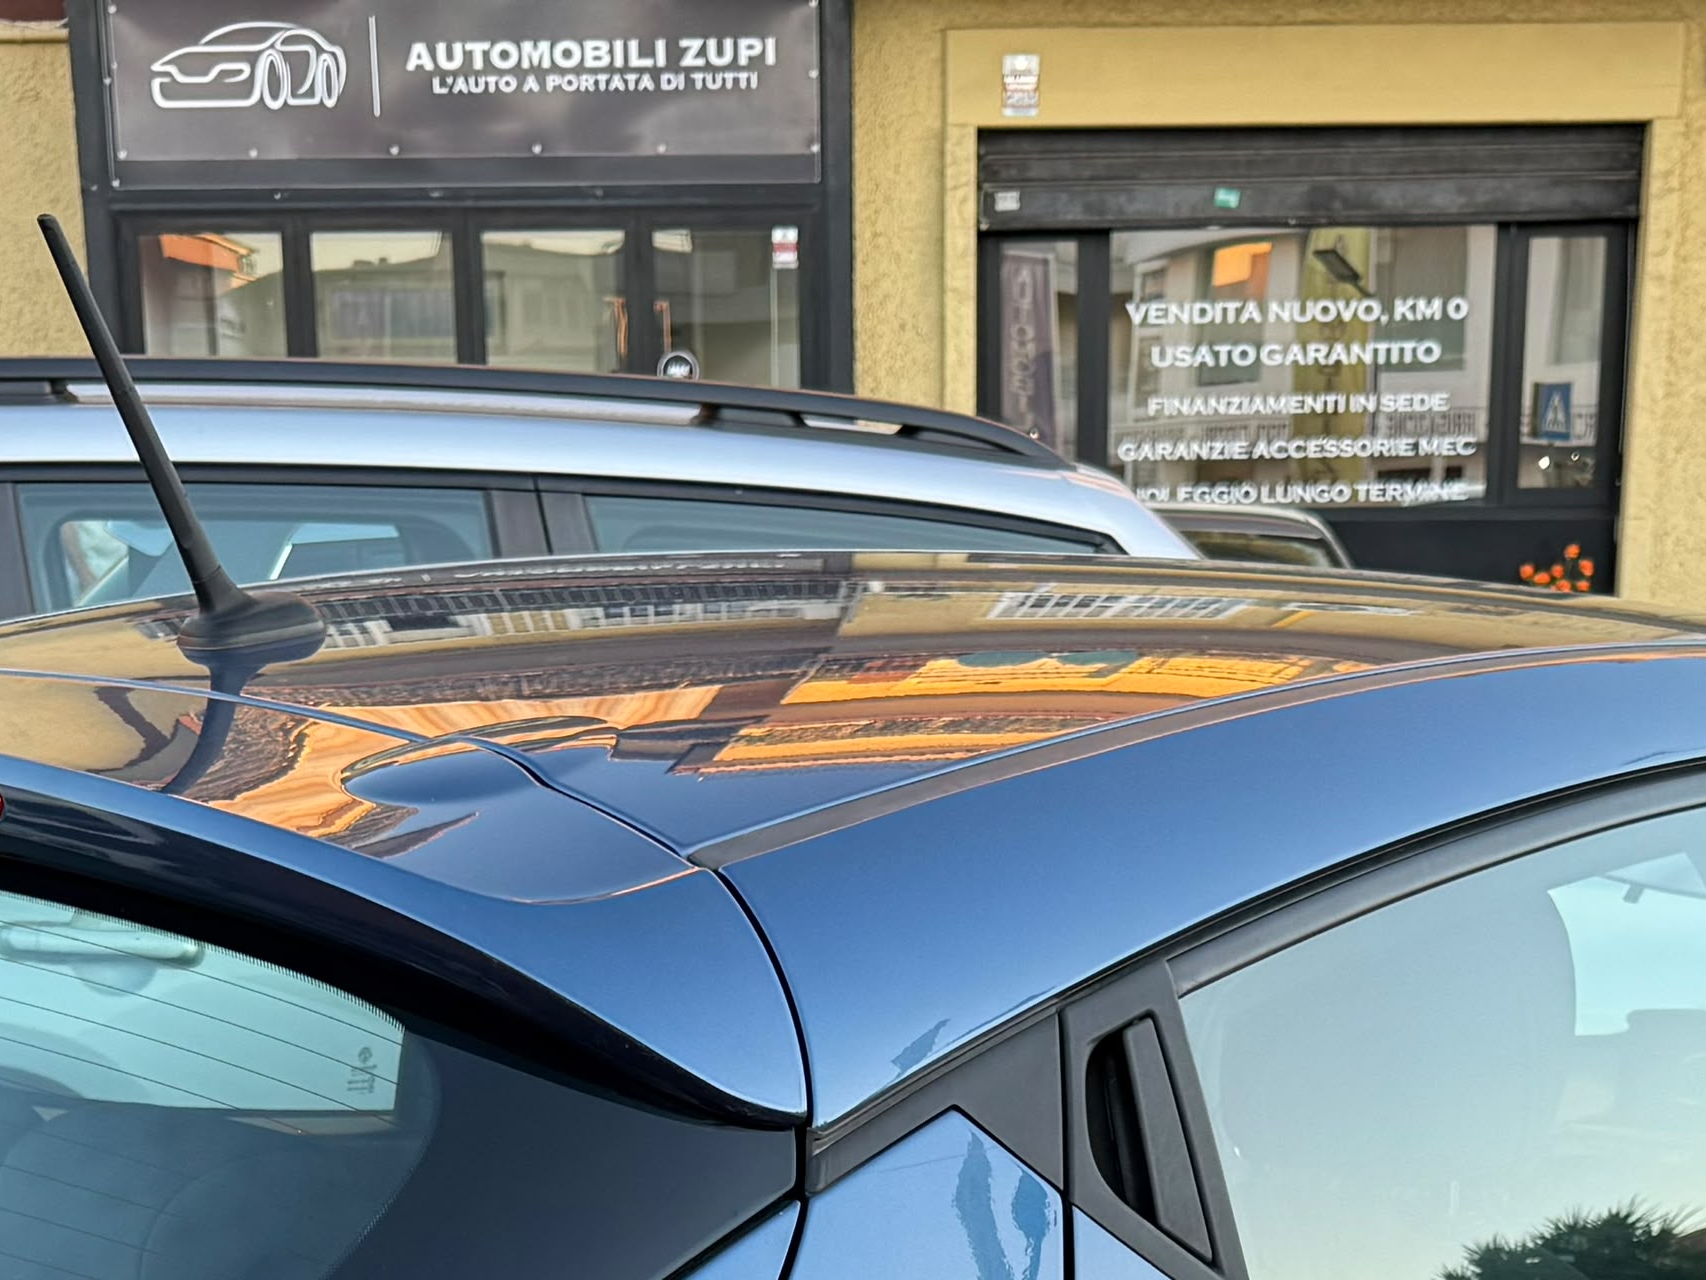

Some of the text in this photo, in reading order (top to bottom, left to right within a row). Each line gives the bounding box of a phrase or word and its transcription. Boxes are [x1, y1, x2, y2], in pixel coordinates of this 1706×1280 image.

[405, 36, 777, 71] AUTOMOBILI ZUPI
[432, 70, 759, 95] L'AUTO A PORTATA DI TUTTI
[1125, 296, 1470, 326] VENDITA NUOVO, KM 0
[1150, 339, 1442, 368] USATO GARANTITO
[1147, 391, 1451, 416] FINANZIAMENTI IN SEDE
[1117, 435, 1478, 461] GARANZIE ACCESSORIE MEC
[1260, 482, 1351, 503] LUNGO
